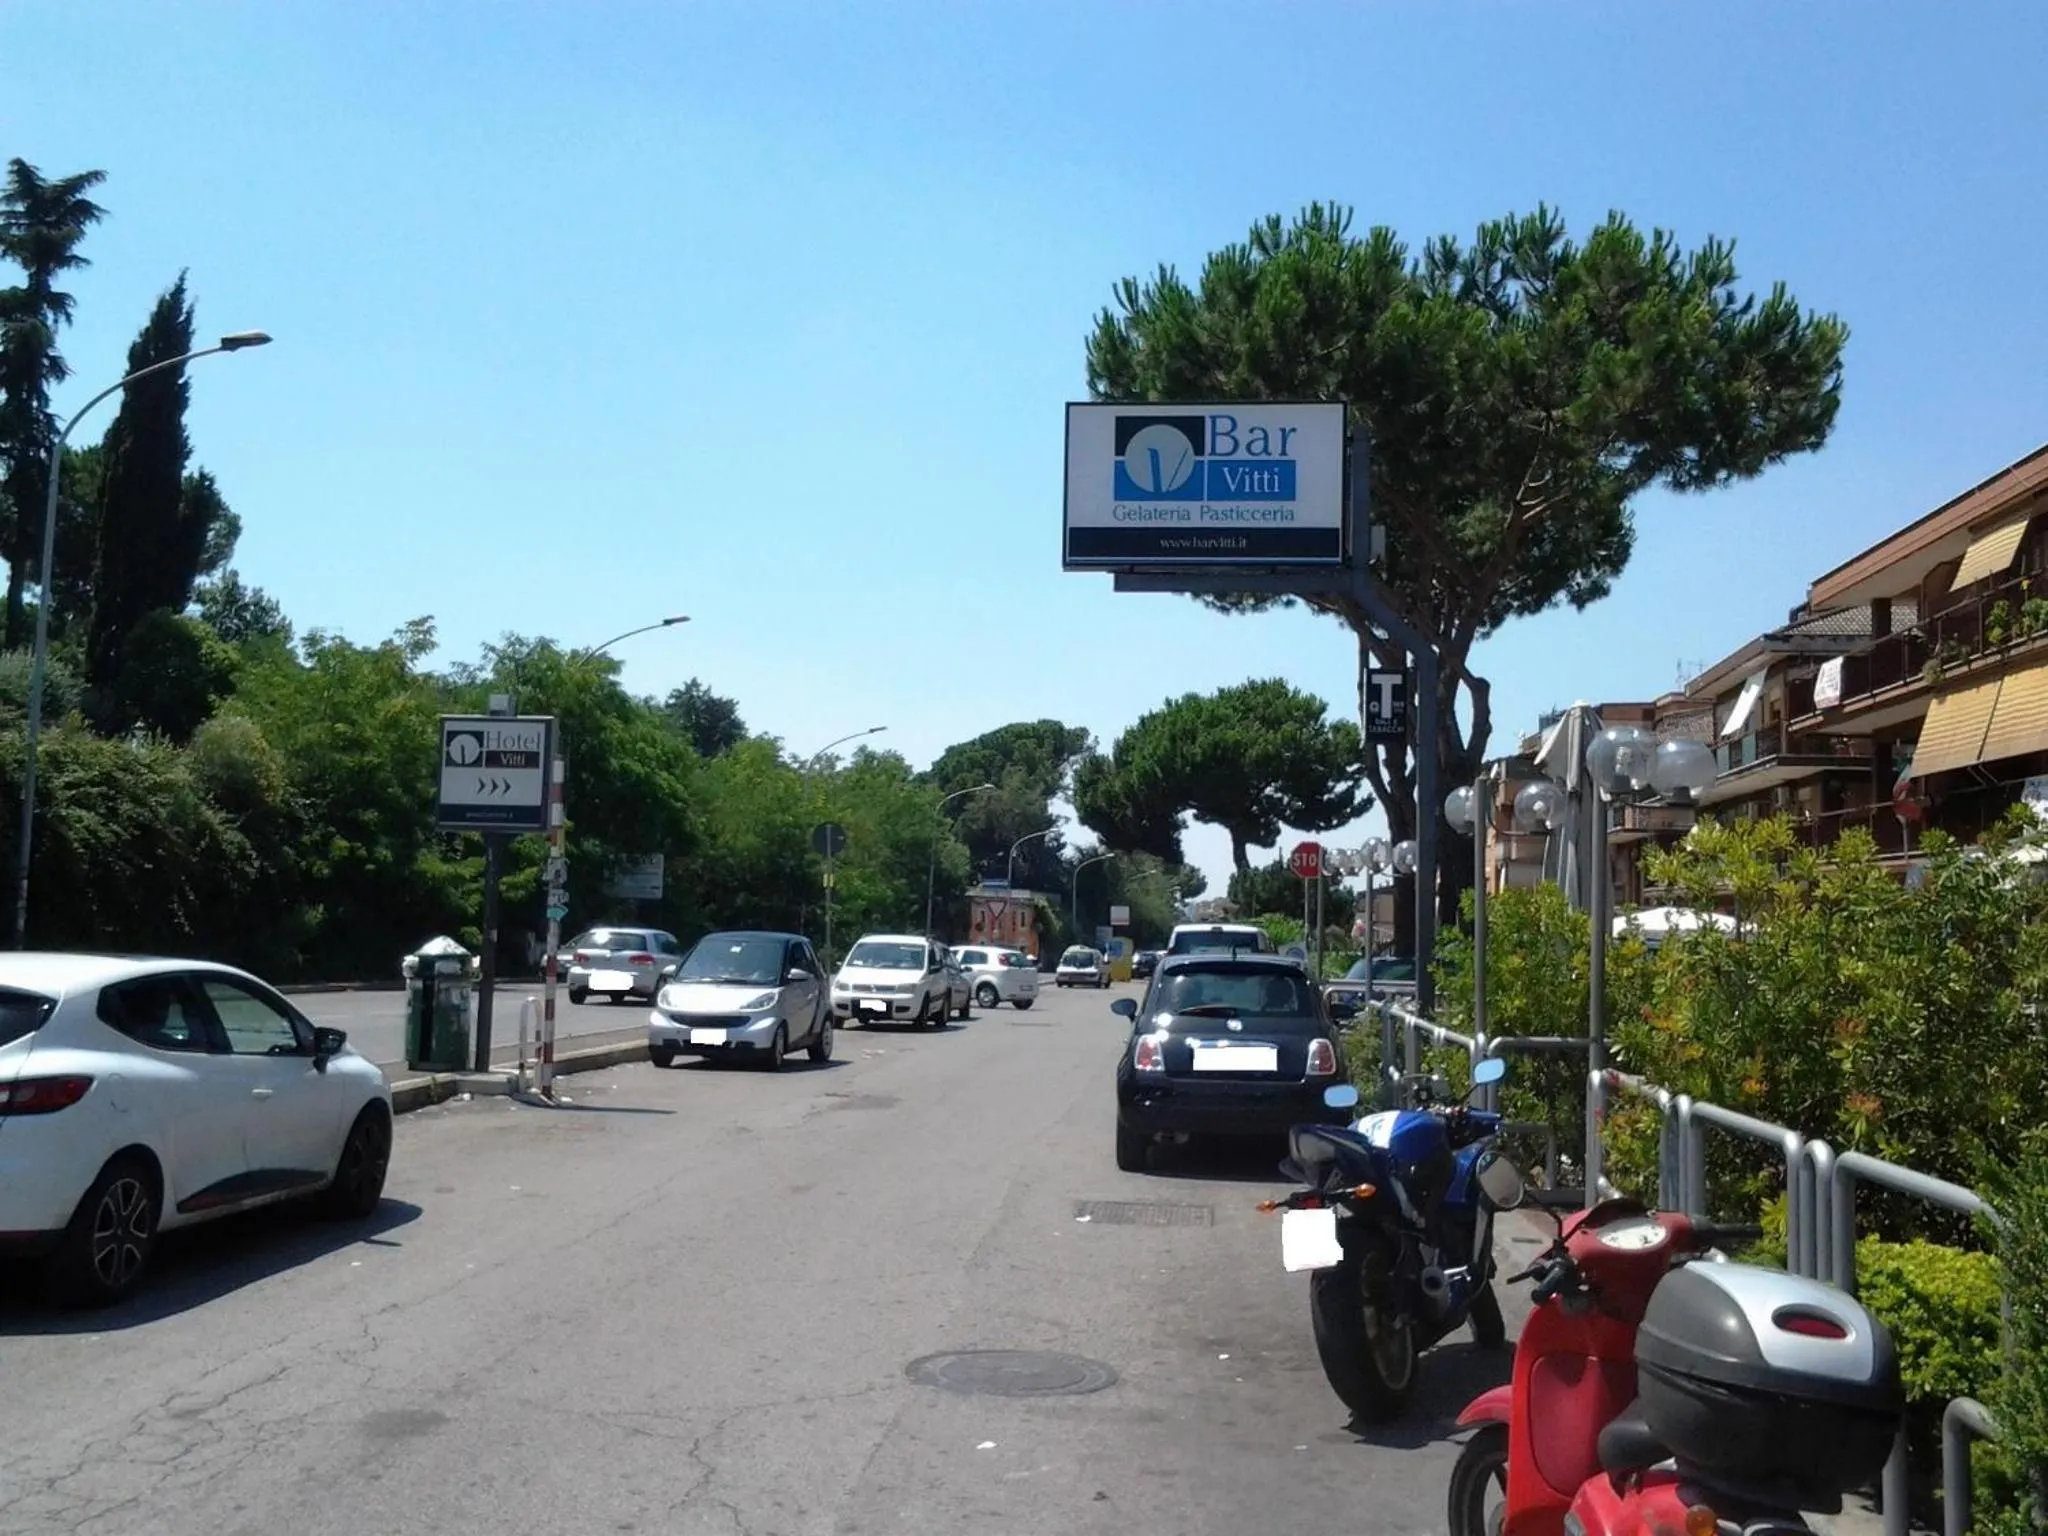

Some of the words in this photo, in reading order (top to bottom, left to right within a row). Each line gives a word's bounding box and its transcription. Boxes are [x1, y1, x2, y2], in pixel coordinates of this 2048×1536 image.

[1208, 414, 1298, 458] Bar
[1223, 466, 1280, 493] Vitti
[1112, 503, 1191, 522] Gelateria
[1200, 503, 1295, 522] Pasticceria
[1371, 674, 1403, 719] T
[486, 730, 541, 750] Hotel
[501, 752, 526, 767] Vitti
[1293, 852, 1318, 867] STO
